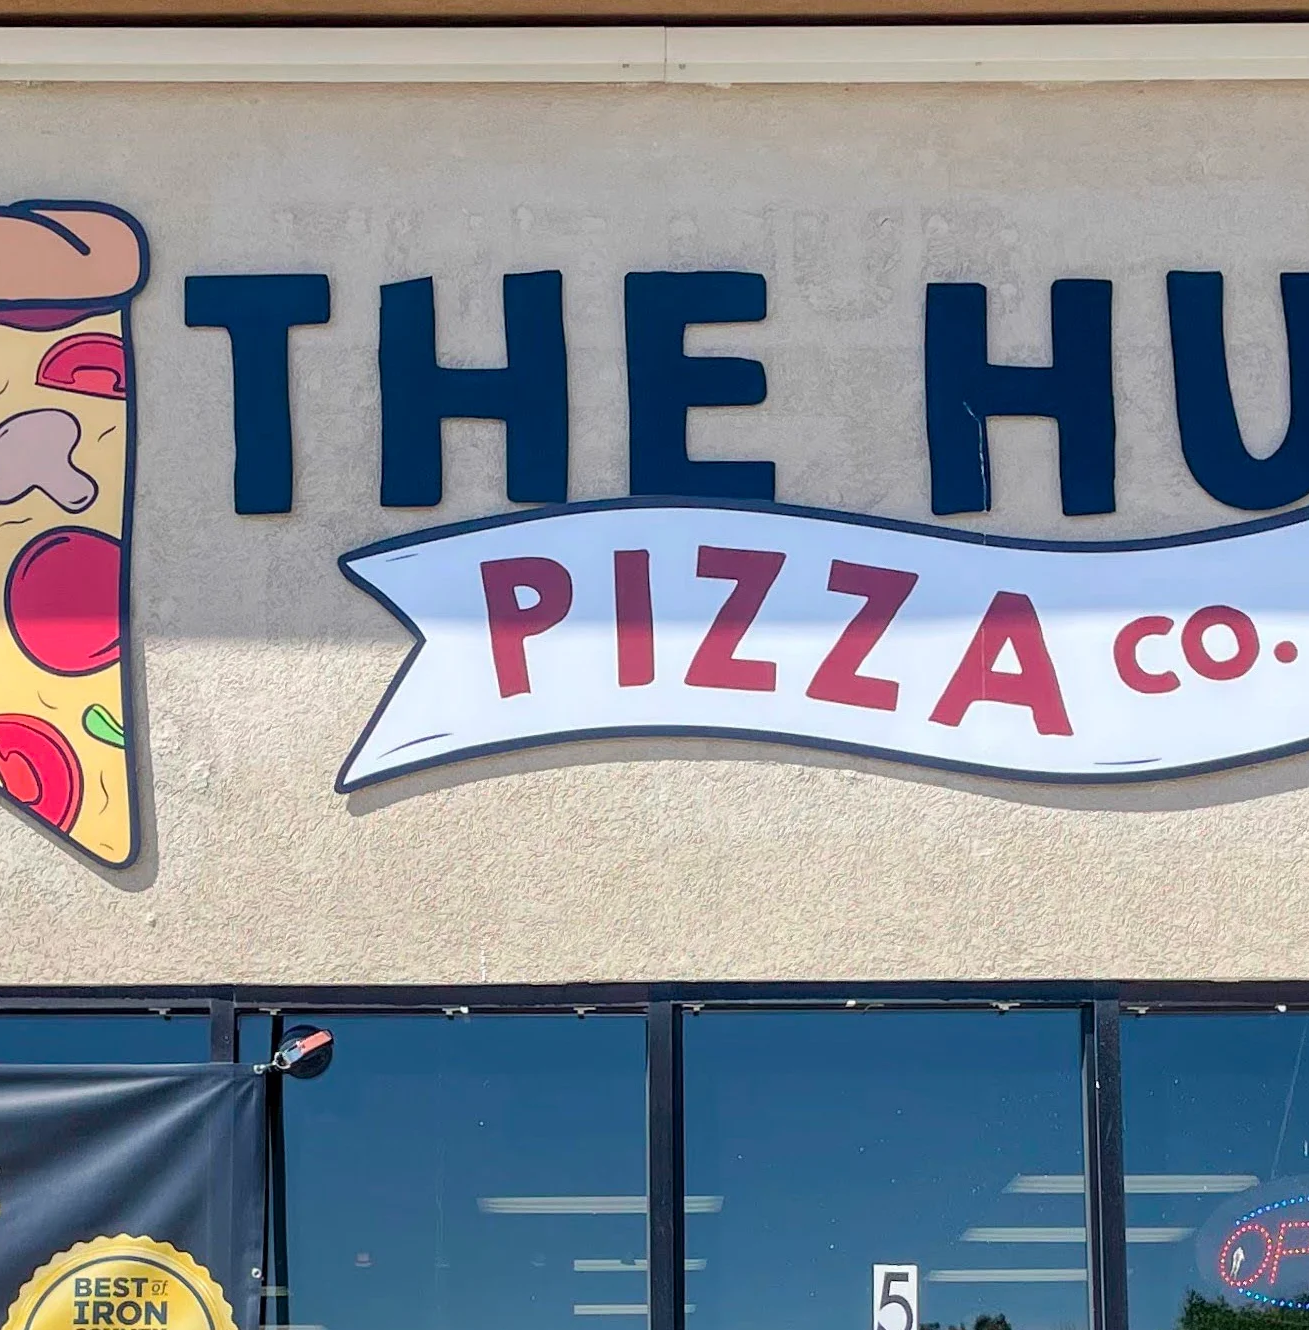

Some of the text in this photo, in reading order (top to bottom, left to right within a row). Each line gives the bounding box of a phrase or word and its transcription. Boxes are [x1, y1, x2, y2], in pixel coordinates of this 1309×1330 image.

[185, 270, 777, 515] THE
[478, 546, 1299, 738] PIZZA CO.
[73, 1301, 168, 1325] IRON
[74, 1277, 168, 1298] BEST of
